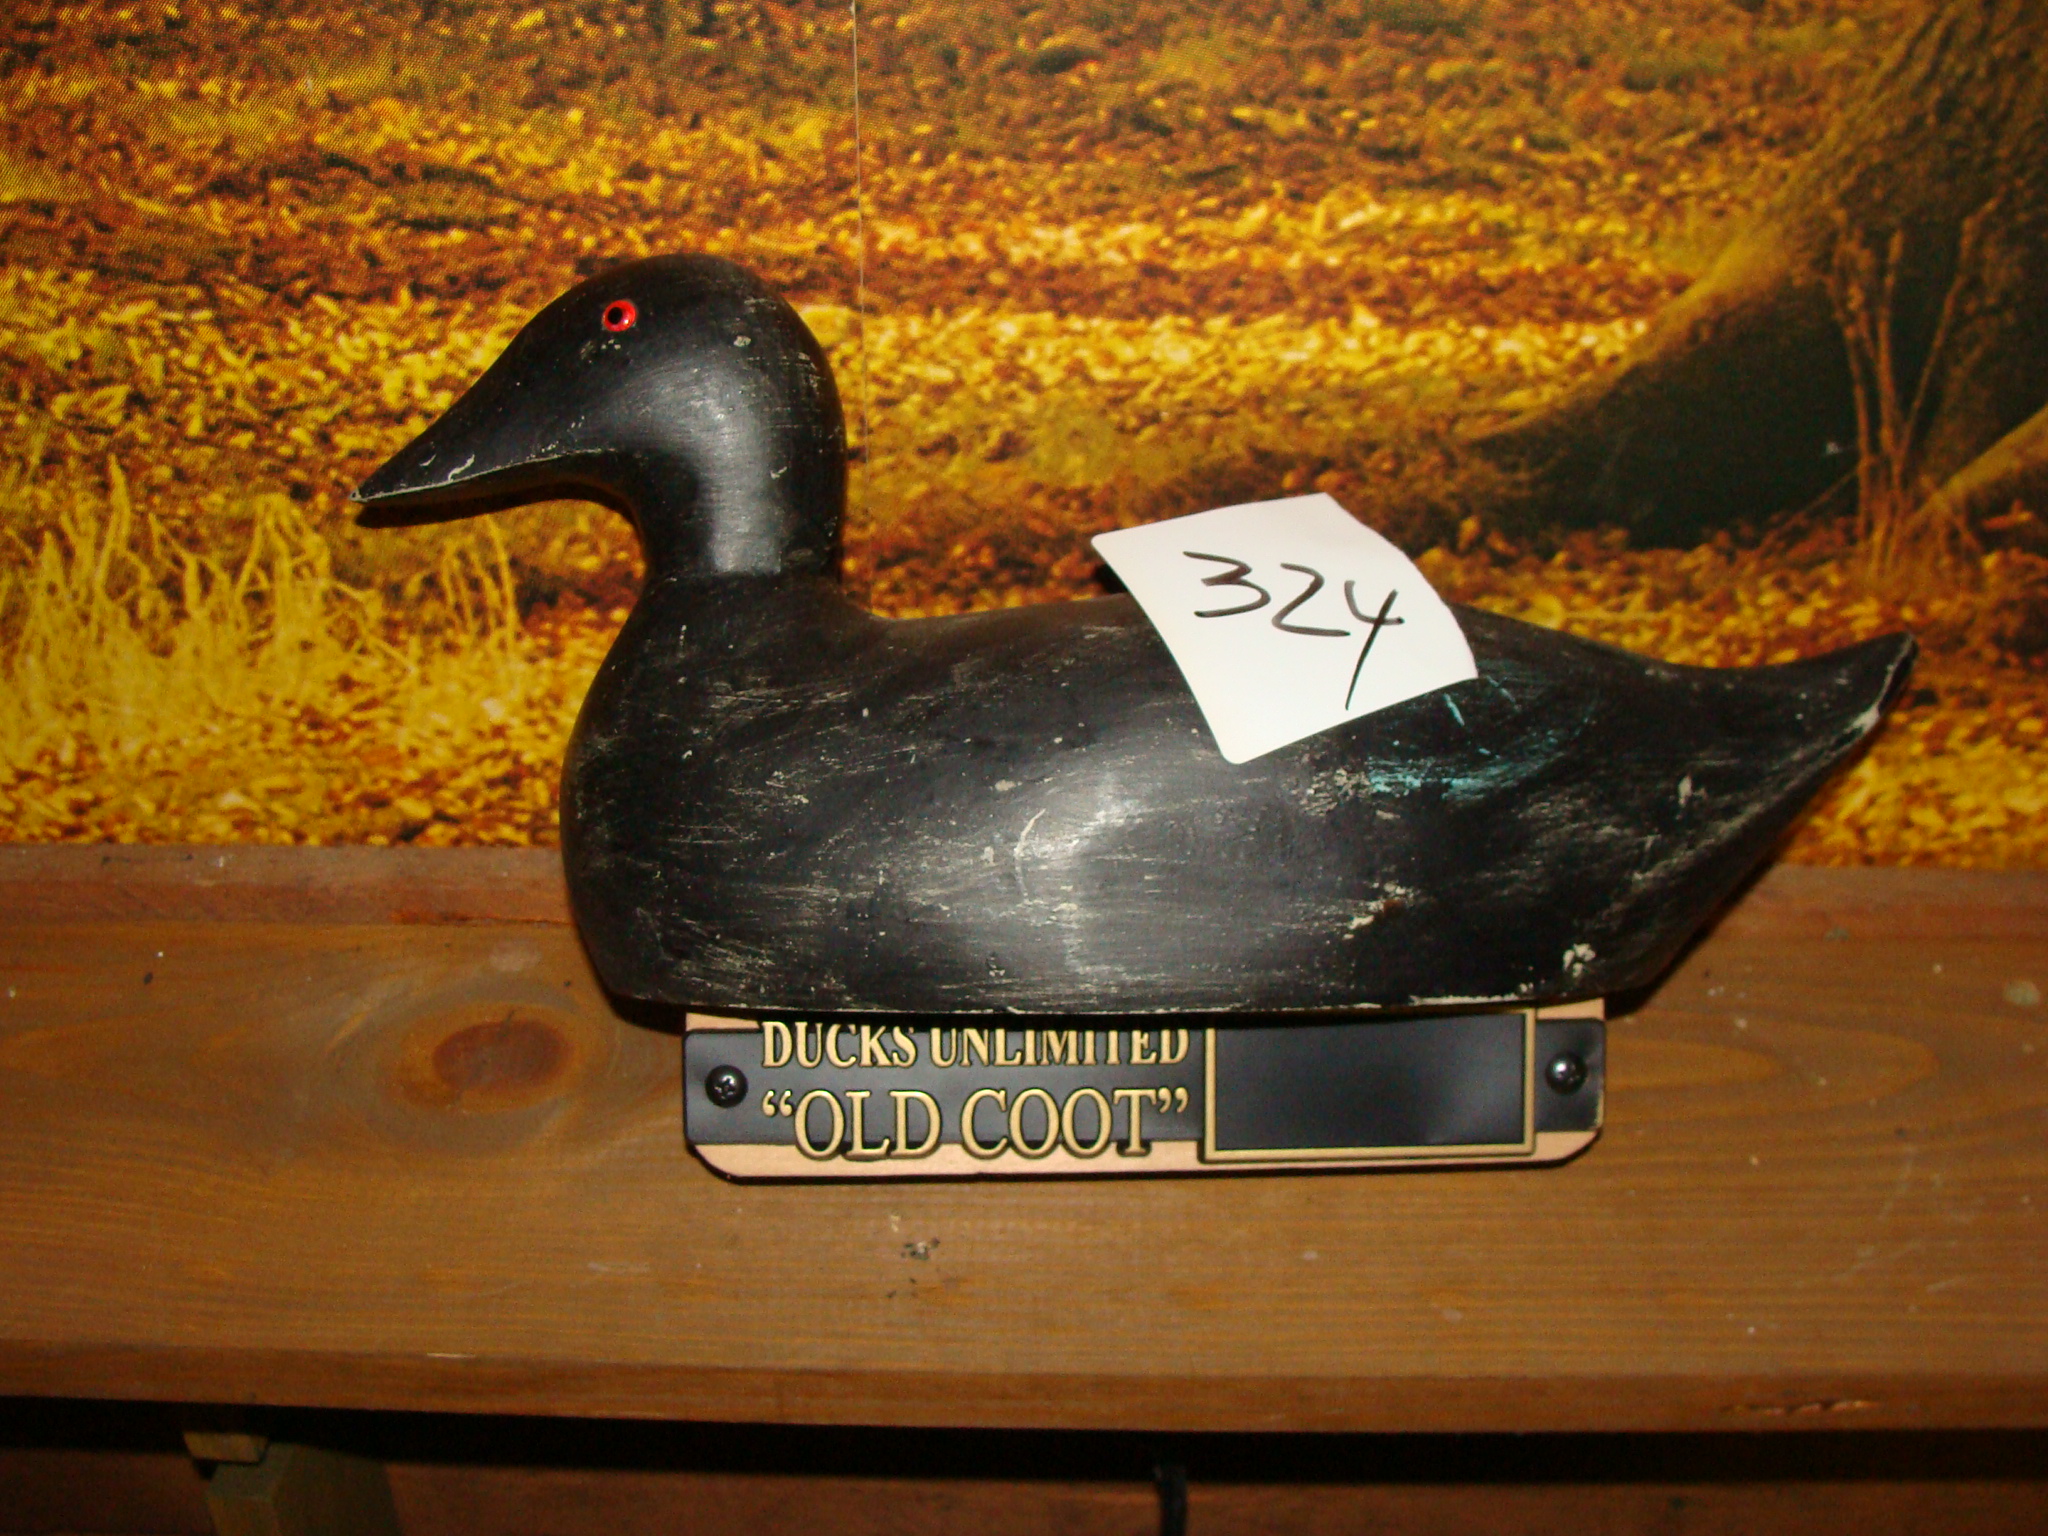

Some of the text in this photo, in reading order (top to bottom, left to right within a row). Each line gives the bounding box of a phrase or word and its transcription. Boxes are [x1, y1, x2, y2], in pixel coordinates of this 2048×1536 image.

[1183, 551, 1405, 710] 324
[762, 1022, 1189, 1068] DUCKS UNLIMITED
